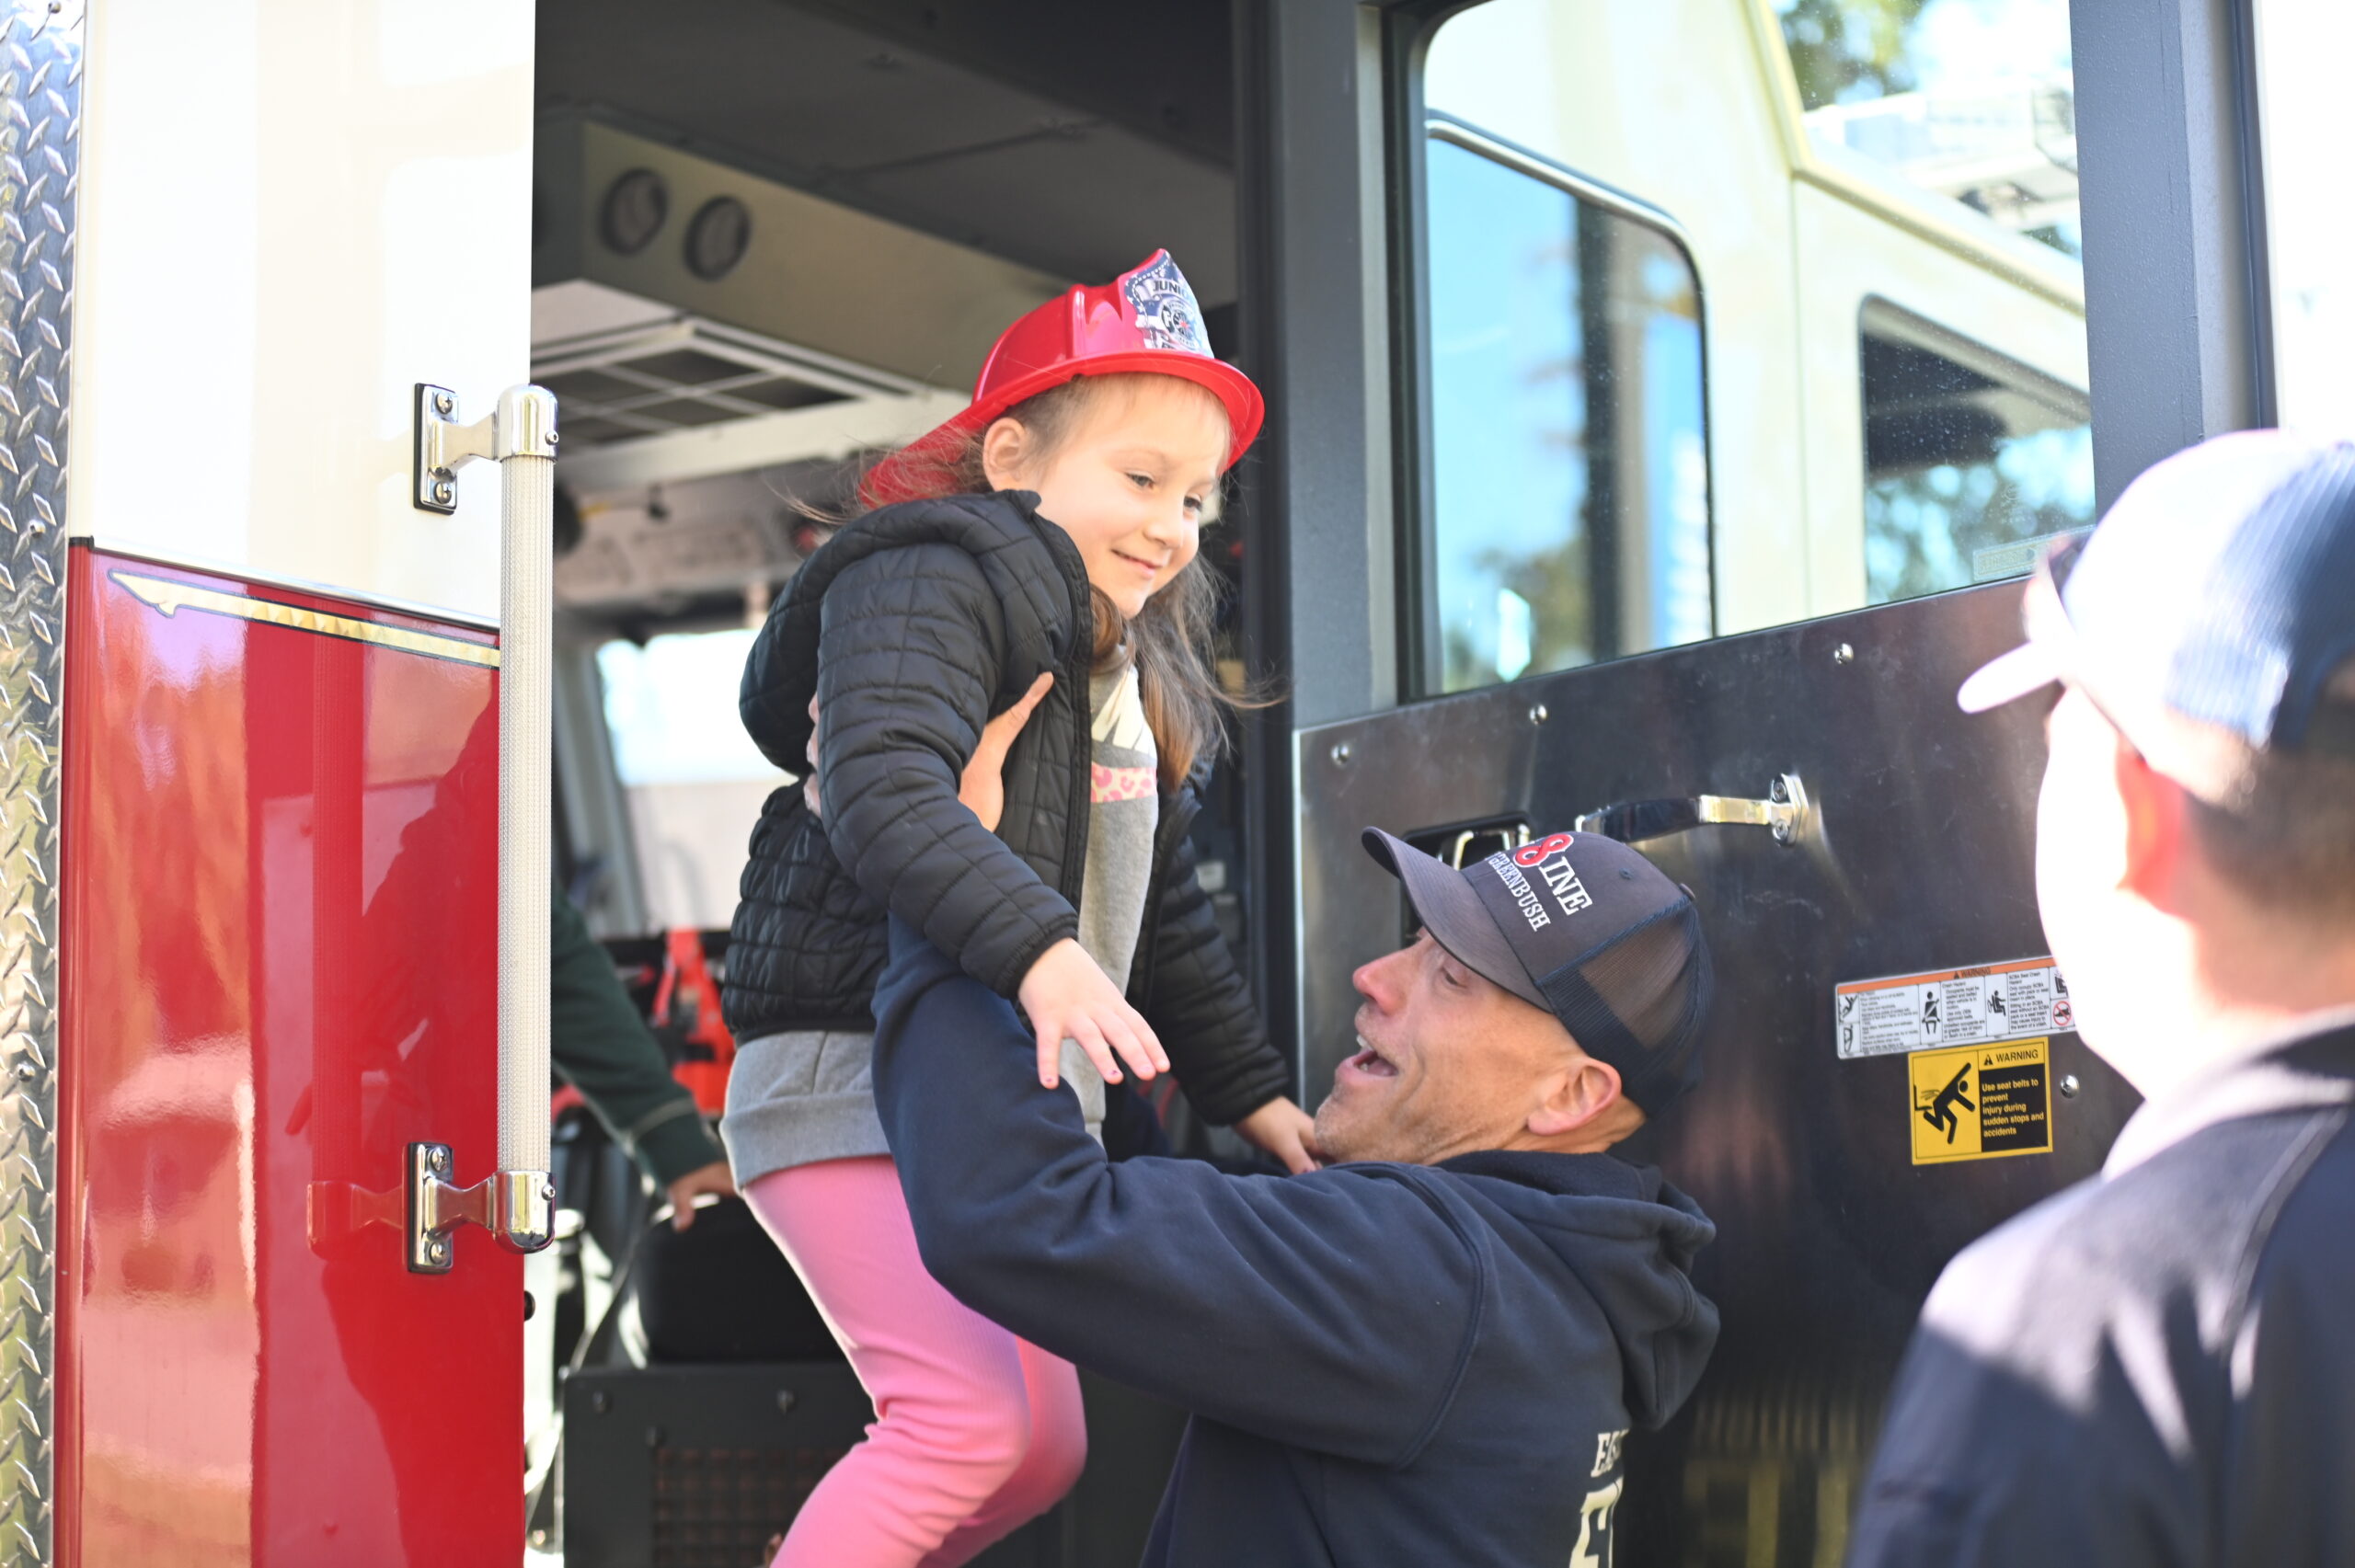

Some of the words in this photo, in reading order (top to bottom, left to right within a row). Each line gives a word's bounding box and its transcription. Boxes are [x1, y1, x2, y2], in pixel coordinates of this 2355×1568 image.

[1153, 280, 1190, 299] JUNIO
[1996, 1049, 2039, 1062] WARNING
[1982, 1083, 1995, 1092] Use
[1997, 1082, 2012, 1090] seat
[2013, 1080, 2029, 1089] belts
[2031, 1079, 2039, 1087] to
[1982, 1093, 2008, 1104] prevent
[1982, 1105, 2002, 1116] injury
[2004, 1104, 2027, 1112] during
[1983, 1116, 2008, 1126] sudden
[2011, 1115, 2029, 1124] stops
[2031, 1112, 2044, 1120] and
[1983, 1127, 2016, 1138] accidents
